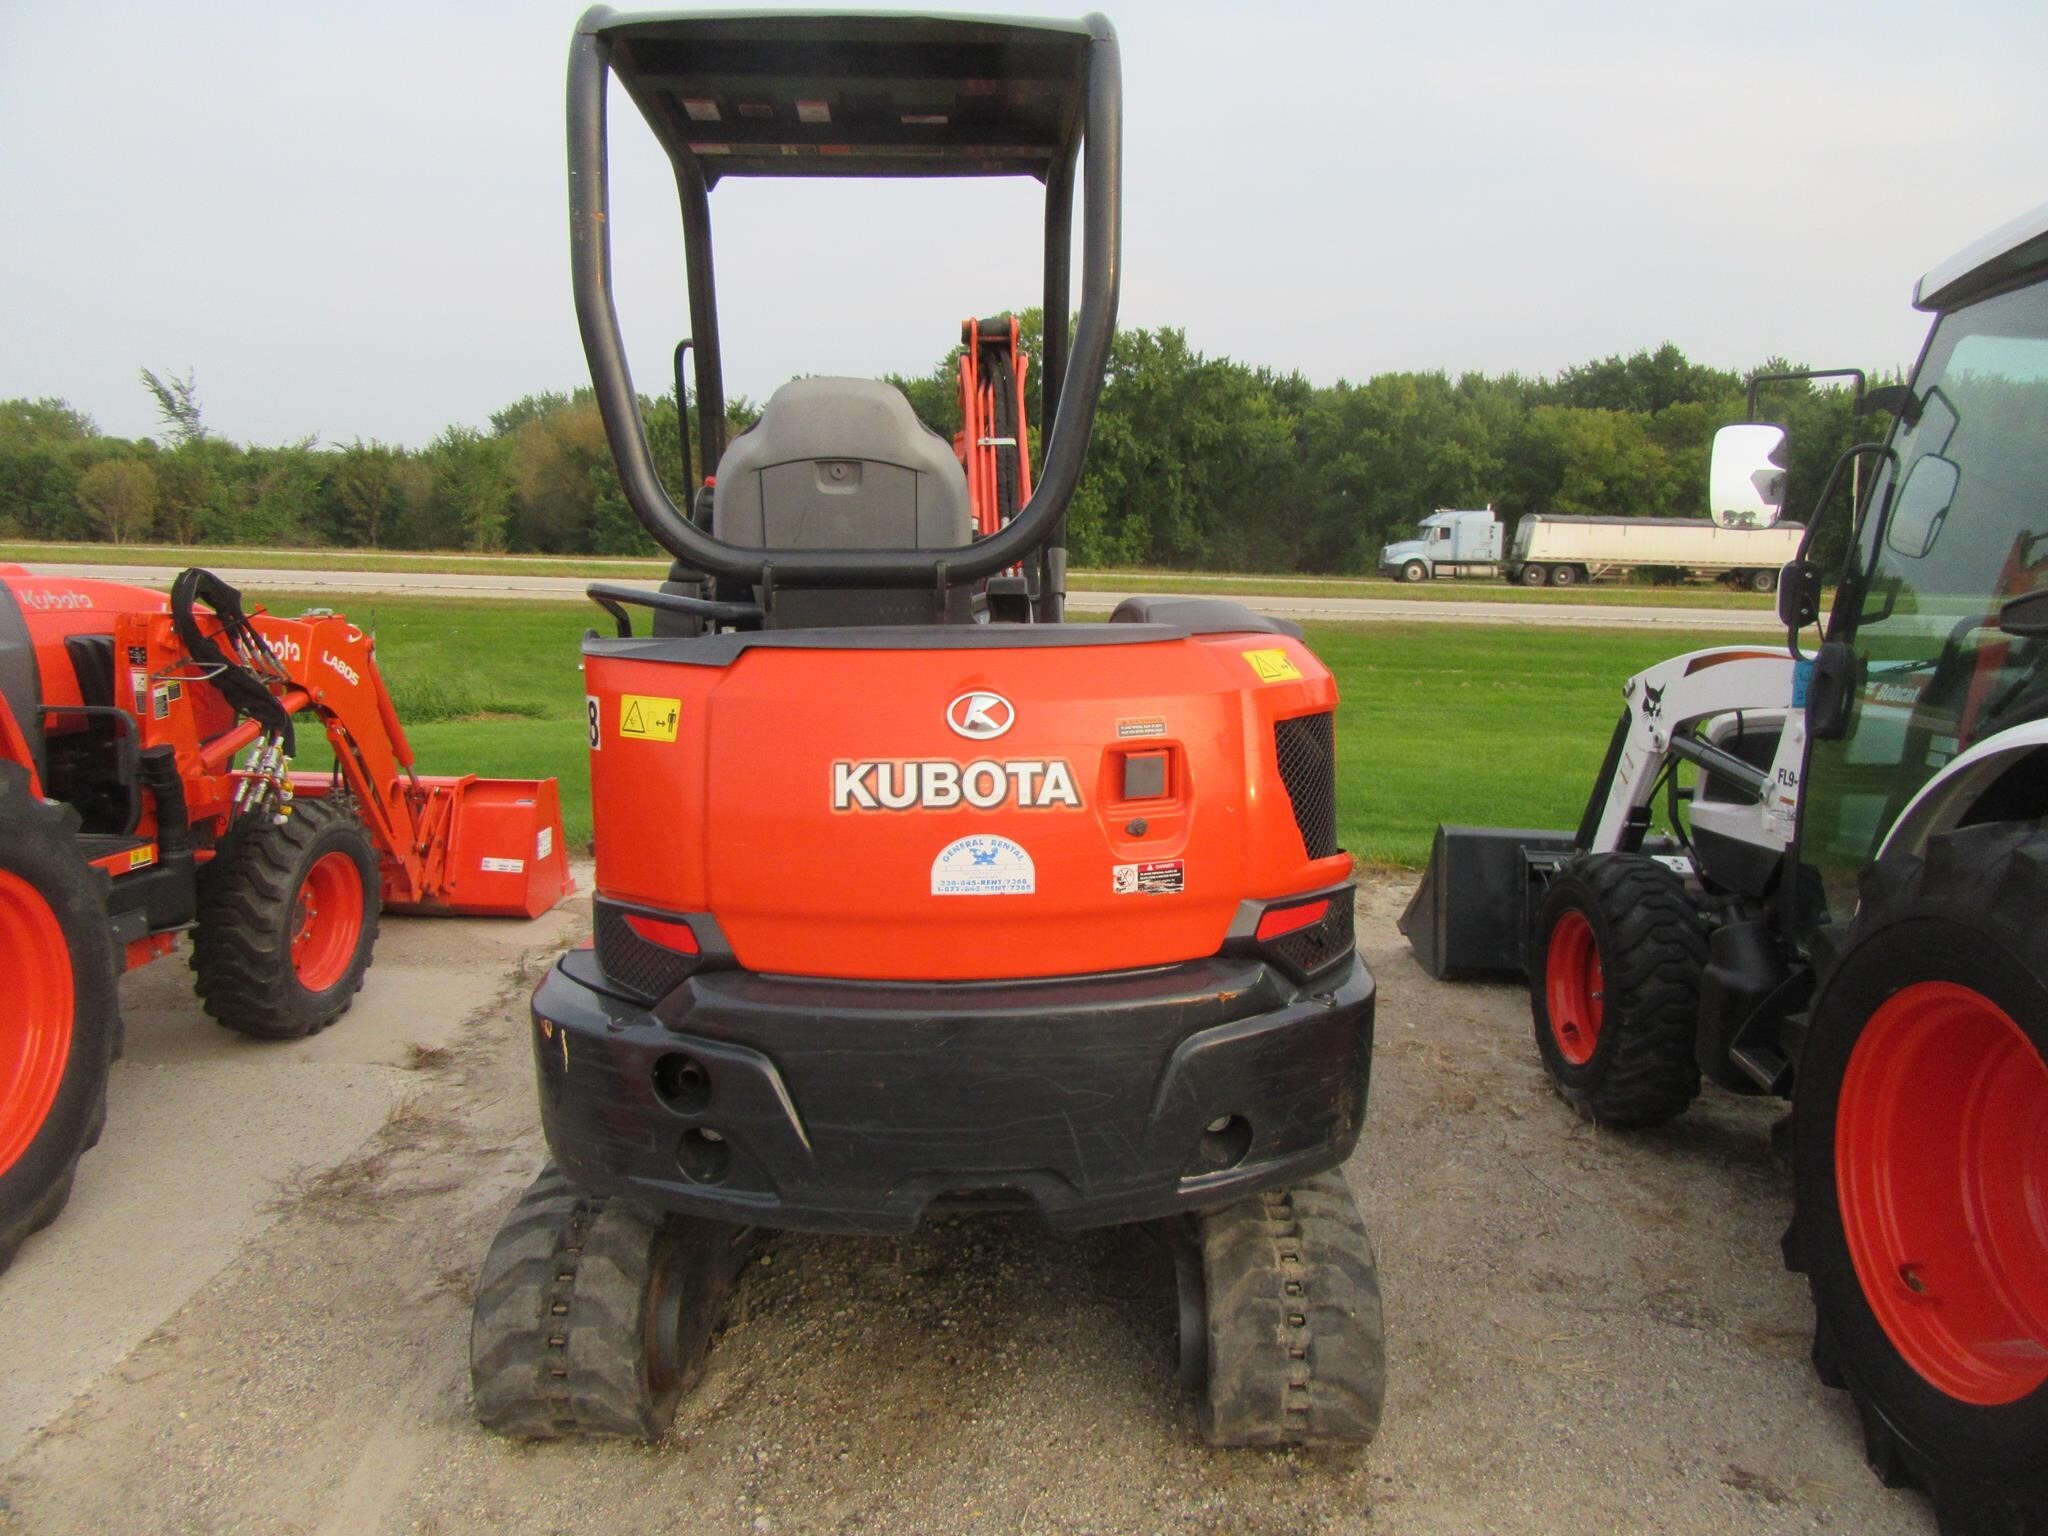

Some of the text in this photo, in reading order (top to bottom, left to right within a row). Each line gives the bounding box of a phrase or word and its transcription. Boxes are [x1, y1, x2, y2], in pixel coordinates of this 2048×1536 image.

[20, 588, 94, 610] Kubota
[317, 650, 360, 688] LA805
[588, 700, 599, 748] 8
[833, 761, 1082, 810] KUBOTA
[942, 839, 1025, 862] GENERAL RENTAL
